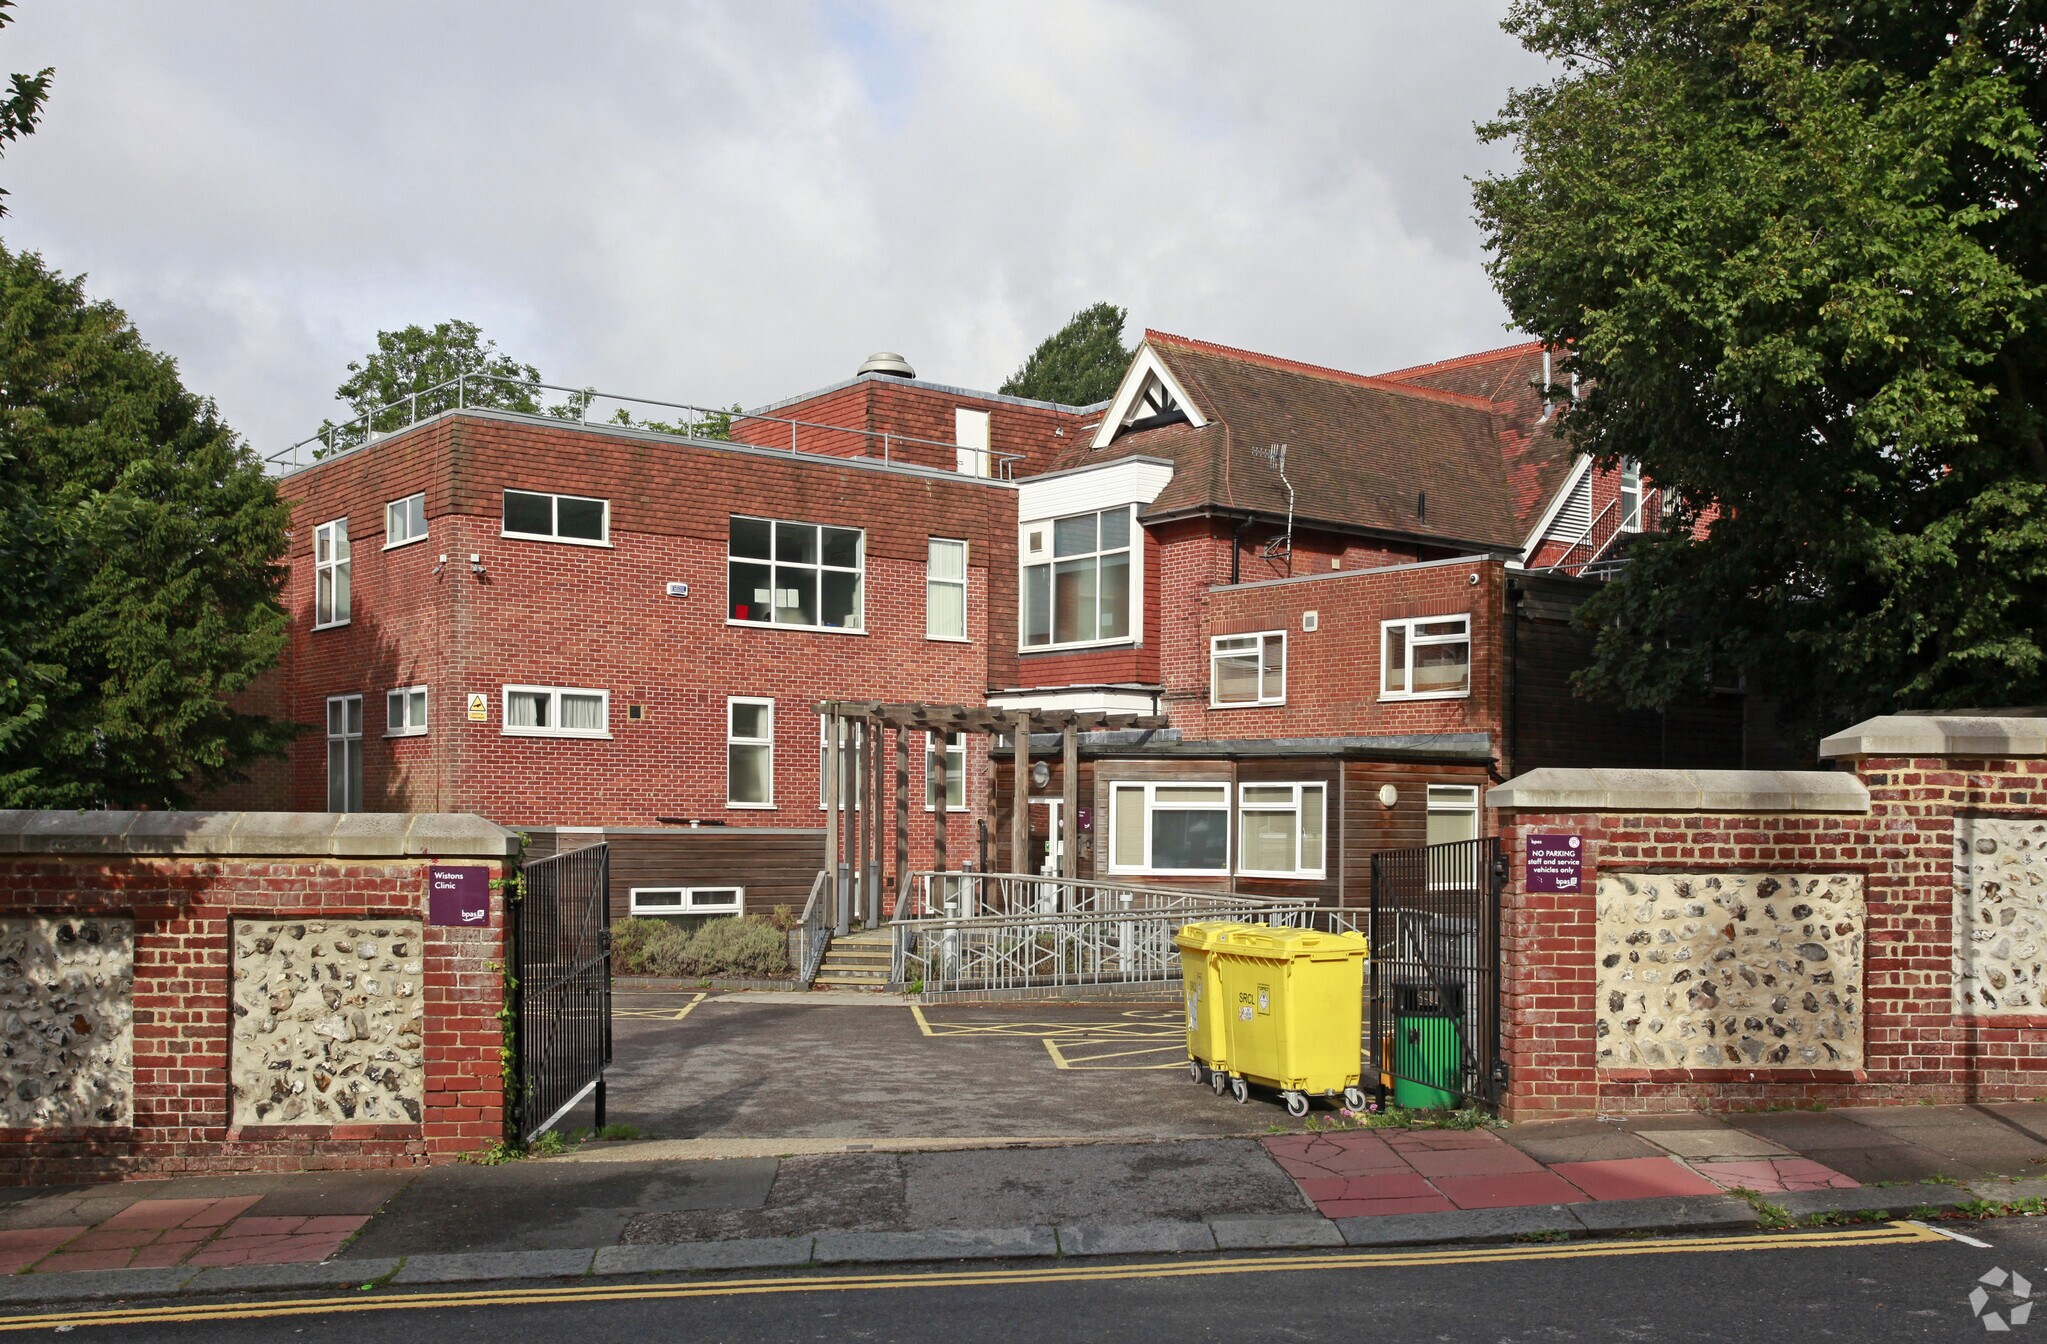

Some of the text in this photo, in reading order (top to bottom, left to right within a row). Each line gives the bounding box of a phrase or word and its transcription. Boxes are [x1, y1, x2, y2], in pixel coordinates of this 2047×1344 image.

[434, 872, 463, 880] Wistons
[434, 881, 456, 889] Clinic
[1556, 877, 1570, 886] bpas
[462, 910, 477, 919] bpas
[1239, 992, 1255, 1005] SRCL
